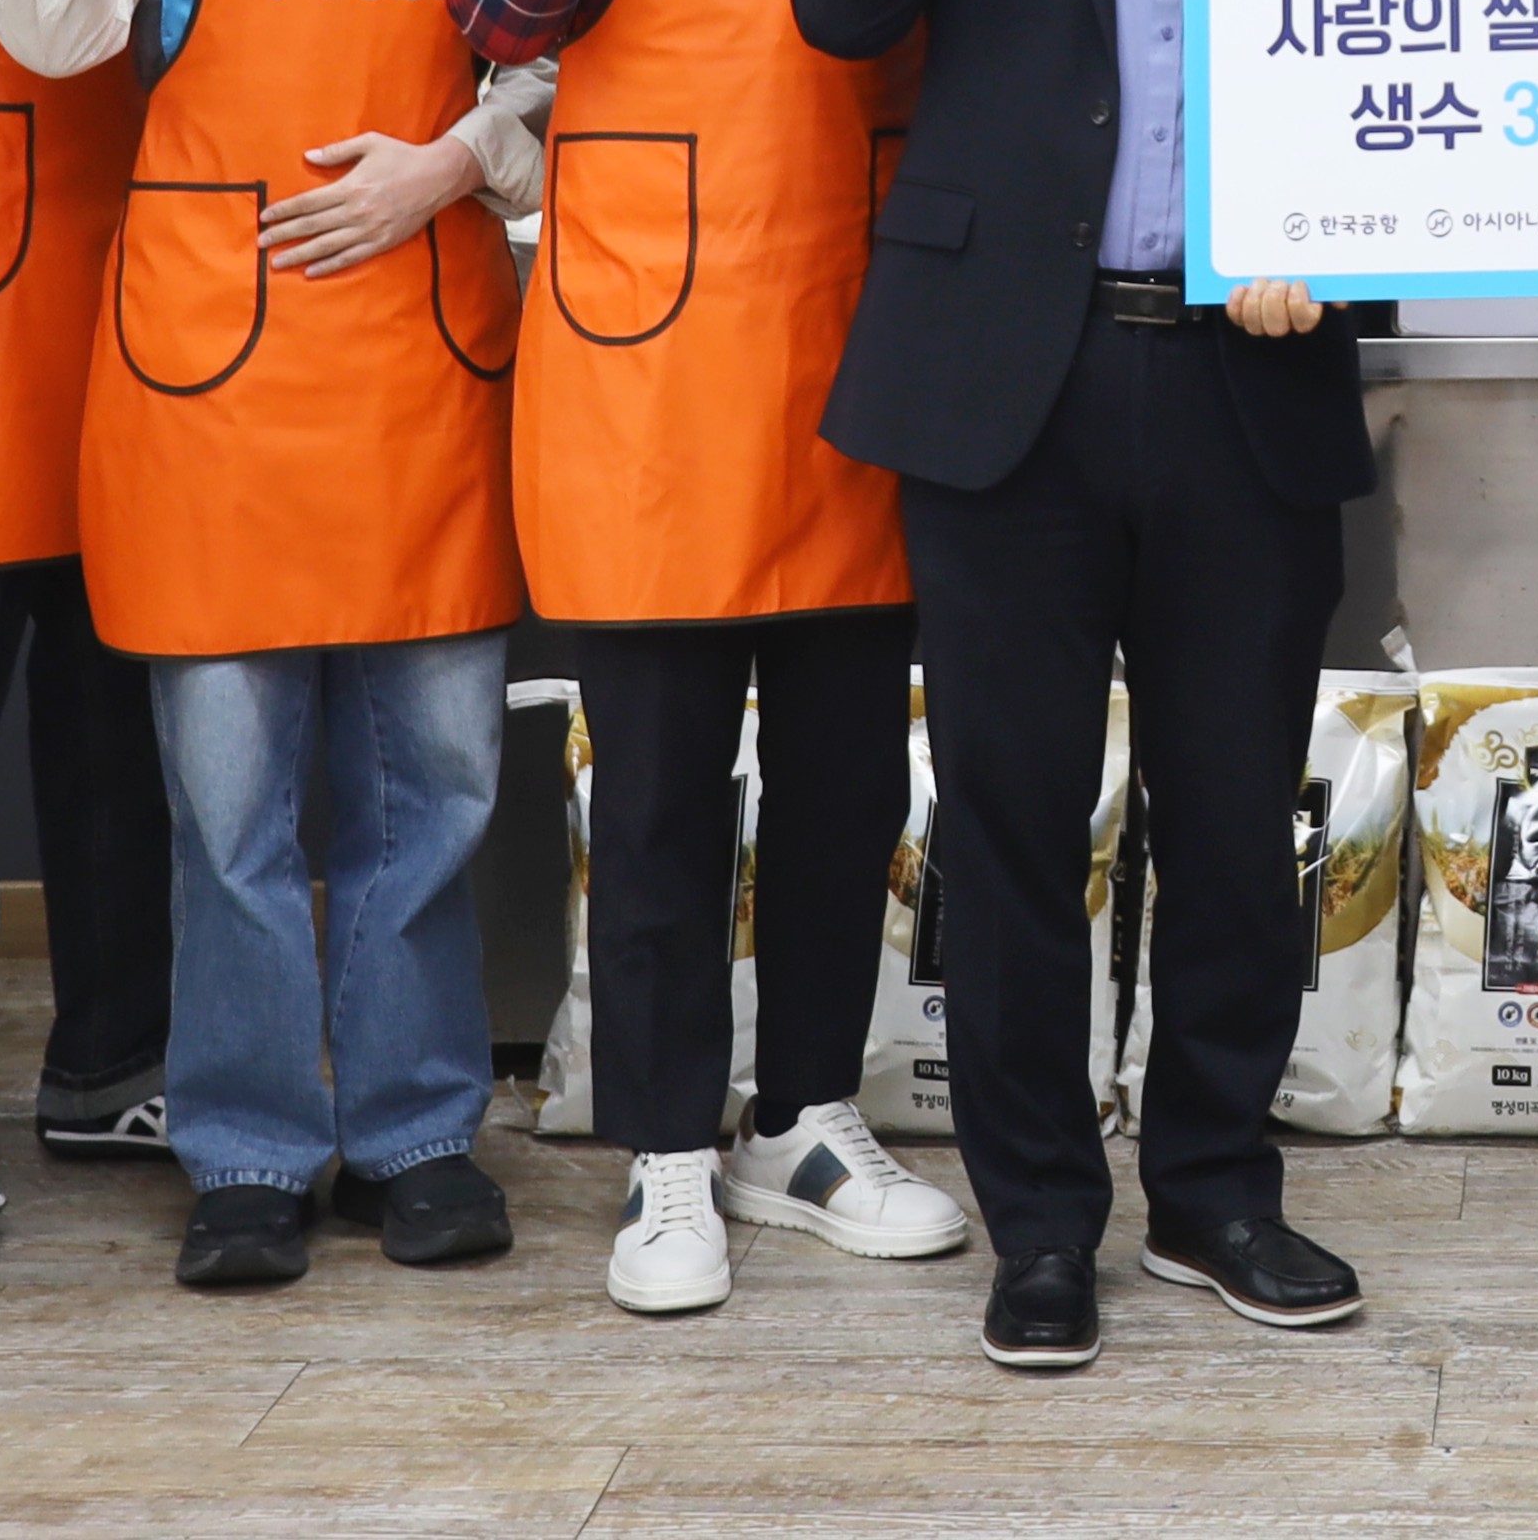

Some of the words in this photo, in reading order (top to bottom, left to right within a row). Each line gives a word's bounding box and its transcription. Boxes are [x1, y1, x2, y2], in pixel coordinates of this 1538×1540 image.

[1349, 80, 1483, 152] 생수
[1319, 212, 1399, 237] 한국공항
[1496, 1068, 1511, 1081] 10
[1512, 1068, 1529, 1083] kg
